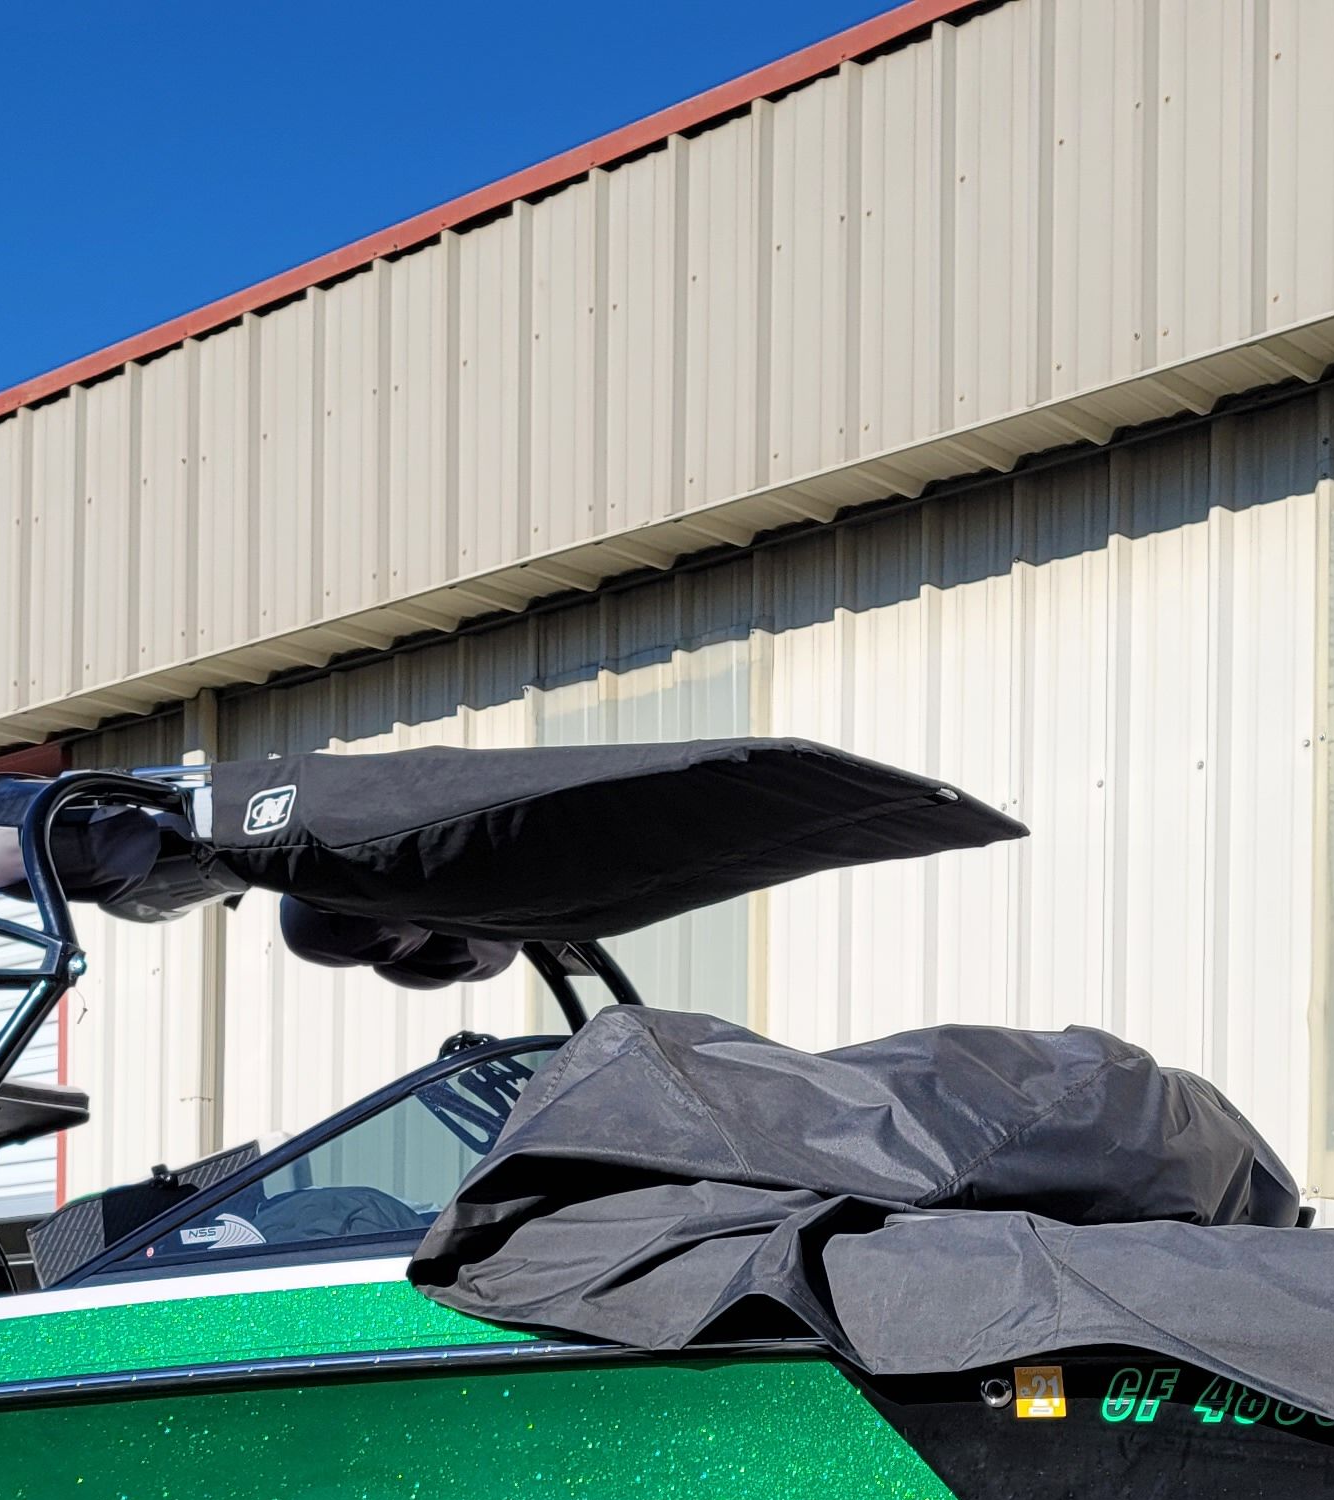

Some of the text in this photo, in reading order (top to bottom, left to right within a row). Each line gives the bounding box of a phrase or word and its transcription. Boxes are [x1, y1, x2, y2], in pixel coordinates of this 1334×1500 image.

[188, 1228, 217, 1239] NSS
[1031, 1375, 1060, 1407] 21
[1101, 1367, 1181, 1422] CF
